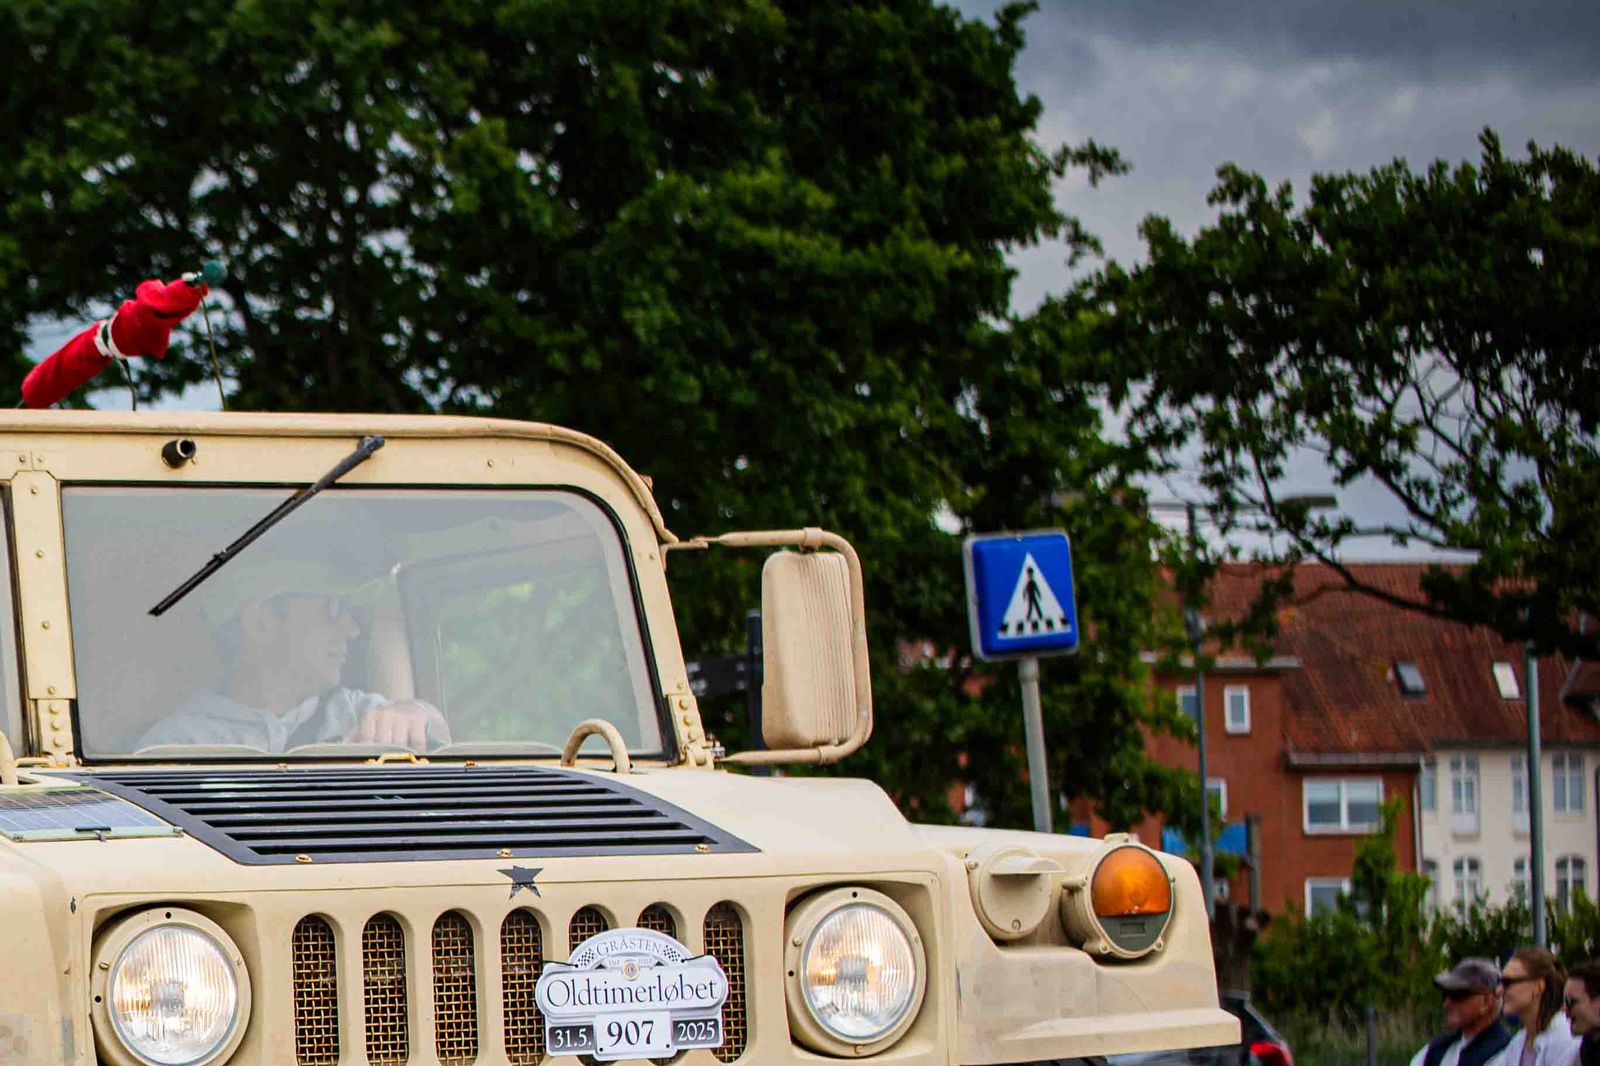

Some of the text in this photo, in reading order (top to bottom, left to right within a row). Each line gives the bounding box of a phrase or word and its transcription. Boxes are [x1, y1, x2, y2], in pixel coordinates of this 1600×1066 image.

[596, 935, 662, 957] GRÅSTEN
[546, 974, 718, 1007] Oldtimerløbet
[554, 1020, 716, 1049] 31.5. 907 2025
